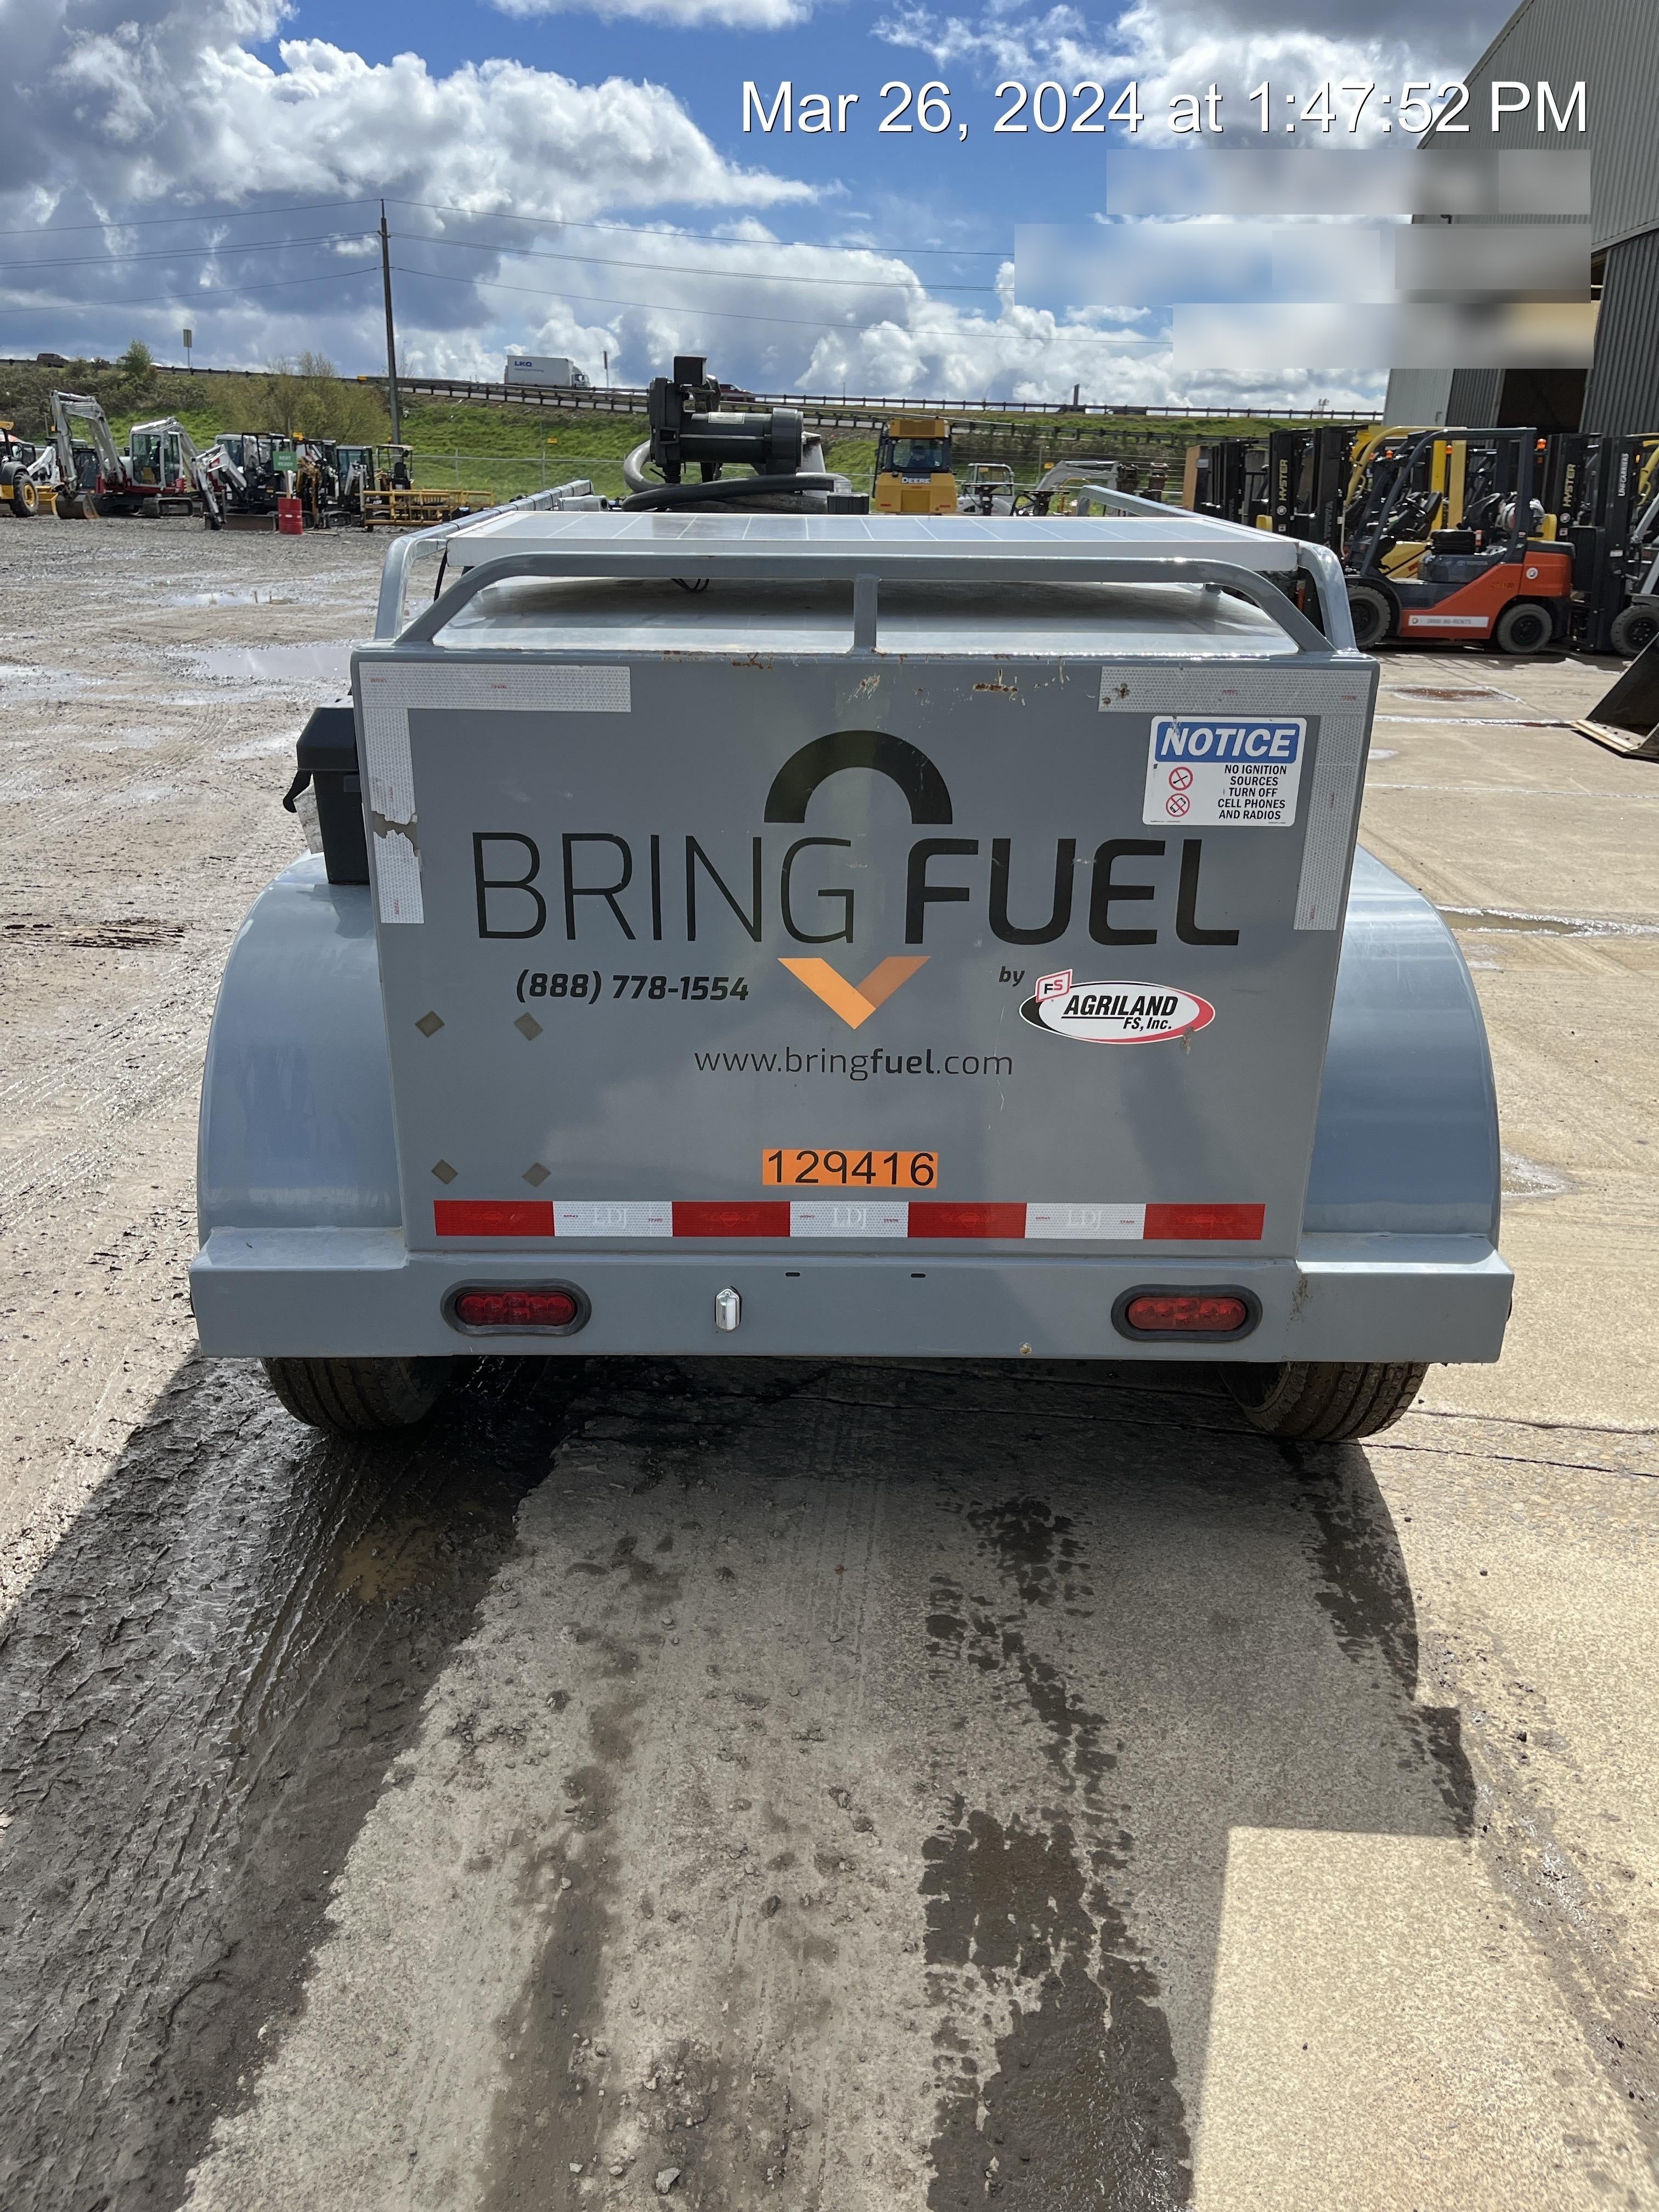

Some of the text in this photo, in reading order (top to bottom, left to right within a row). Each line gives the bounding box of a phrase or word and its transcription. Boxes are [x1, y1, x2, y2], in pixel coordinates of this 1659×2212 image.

[1278, 459, 1289, 501] HYSTER
[1562, 464, 1576, 507] HYSTER
[1160, 727, 1296, 757] NOTICE
[1224, 764, 1287, 775] NO IGNITION
[1230, 776, 1278, 786] SOURCES
[1229, 787, 1278, 797] TURN OFF
[1218, 799, 1285, 809] CELL PHONES
[1218, 810, 1281, 820] AND RADIOS
[472, 832, 1240, 946] BRING FUEL
[516, 969, 749, 1005] (888) 778-1554
[998, 966, 1025, 987] by
[1044, 979, 1063, 994] FS
[1063, 995, 1178, 1016] AGRILAND
[1123, 1017, 1172, 1031] FS, Inc.
[694, 1047, 1013, 1081] www.bringfuel.com
[768, 1150, 934, 1186] 129416
